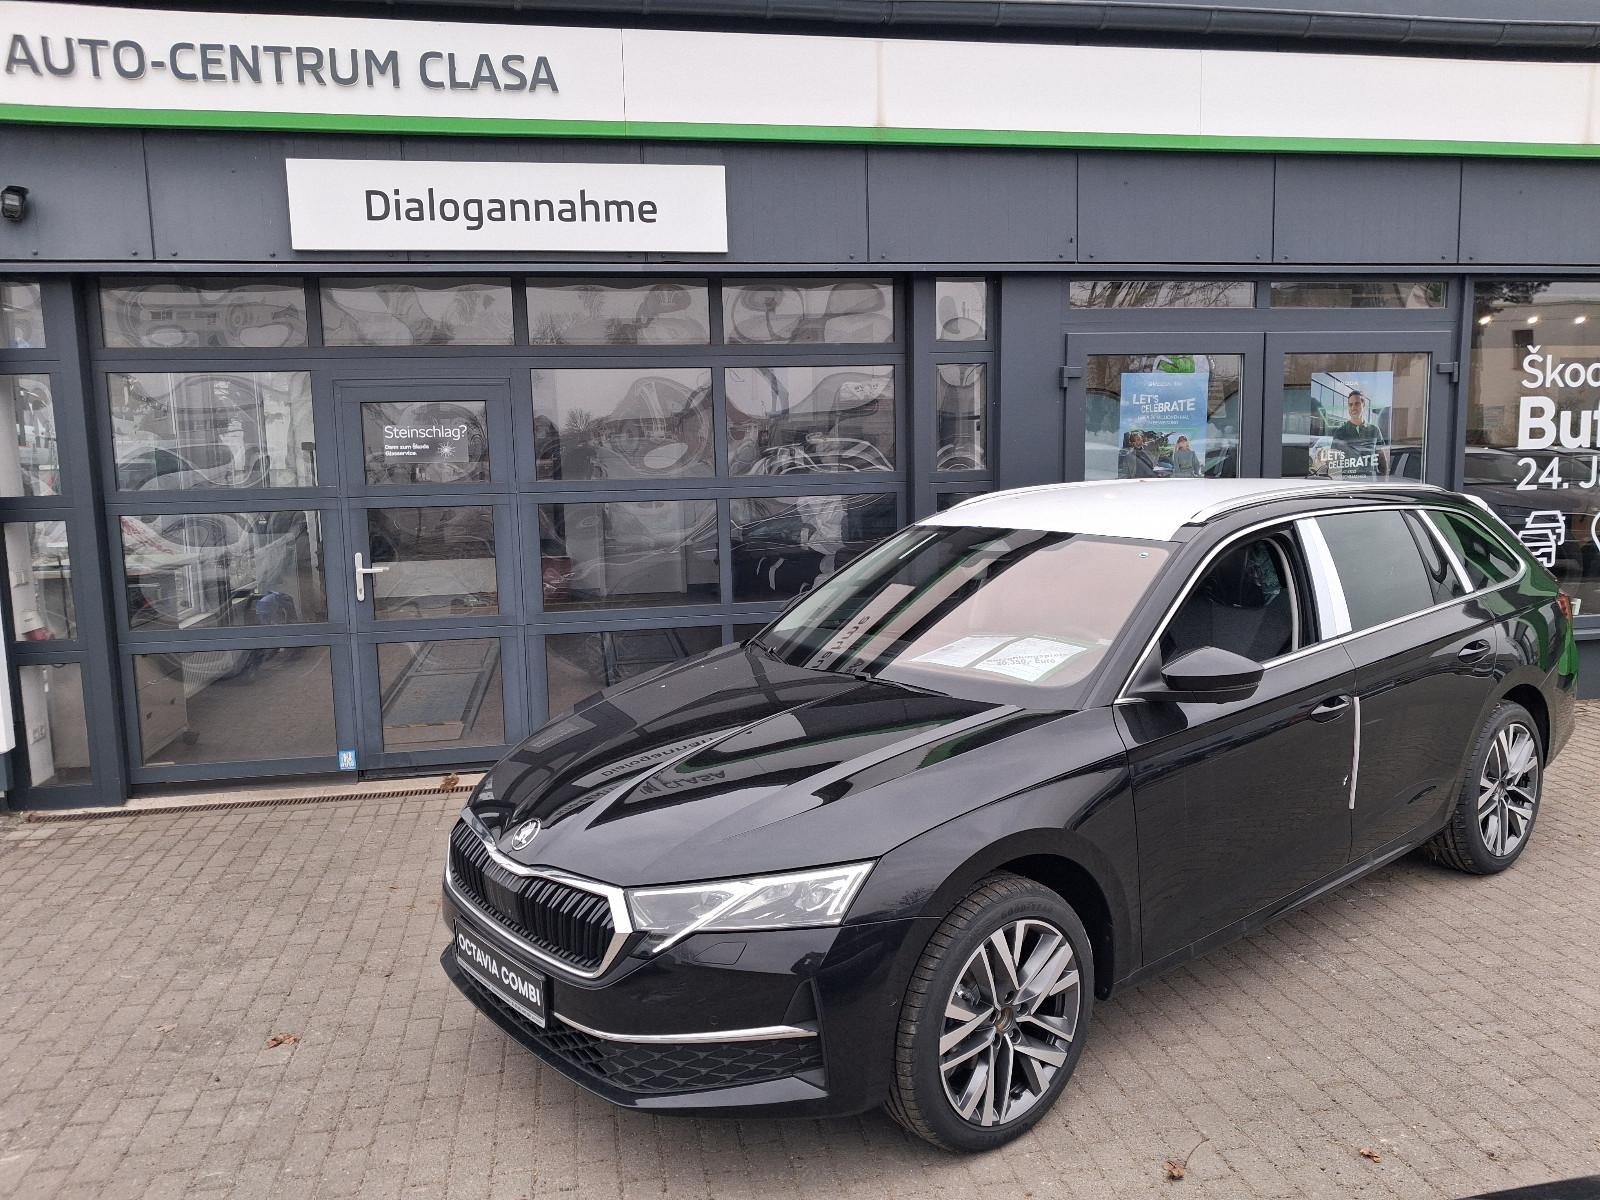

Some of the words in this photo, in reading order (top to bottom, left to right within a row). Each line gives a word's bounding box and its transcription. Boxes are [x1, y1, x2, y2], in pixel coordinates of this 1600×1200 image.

[5, 34, 400, 89] AUTO-CENTRUM
[419, 51, 559, 93] CLASA
[365, 188, 658, 231] Dialogannahme
[1132, 393, 1159, 405] LET'S
[1141, 398, 1196, 413] CELEBRATE
[384, 425, 467, 441] Steinschlag?
[1328, 453, 1380, 469] CELEBRATE
[1516, 456, 1569, 491] 24.
[1035, 657, 1056, 665] Euro
[458, 933, 500, 979] OCTAVIA
[501, 966, 541, 1007] COMBI
